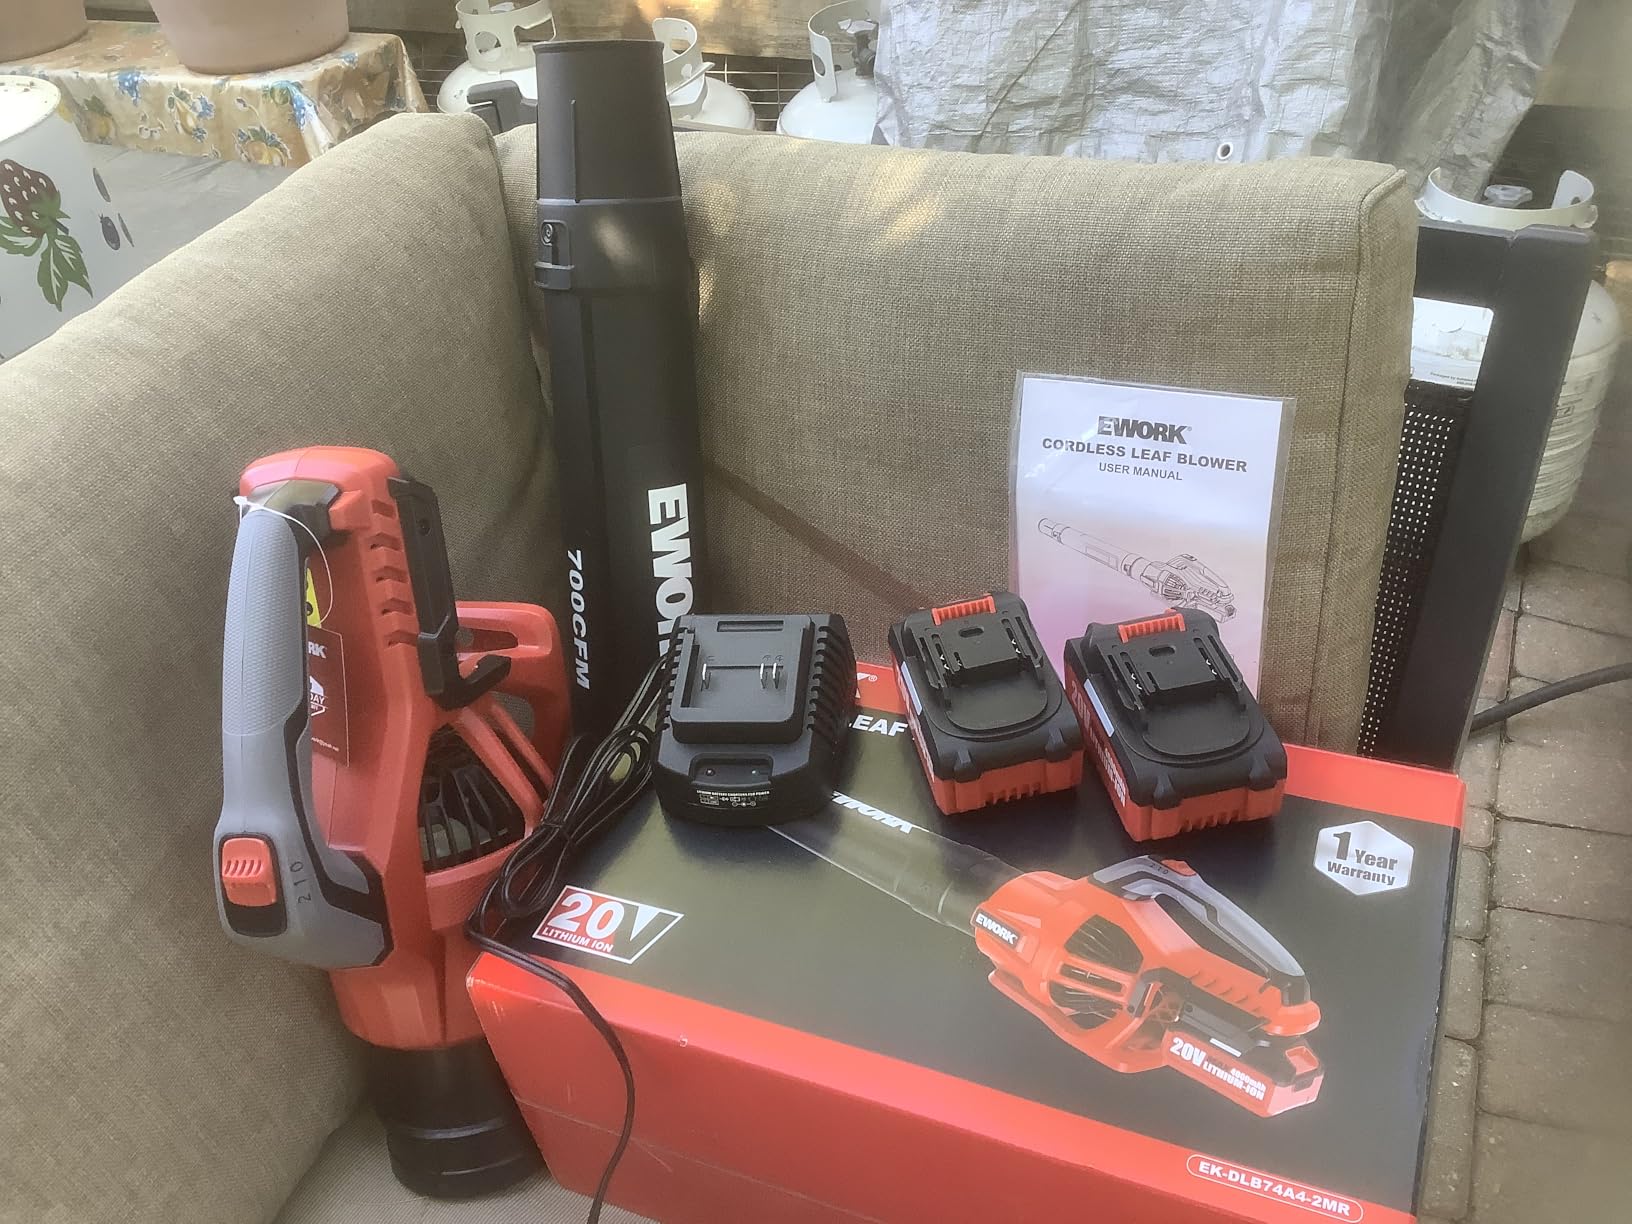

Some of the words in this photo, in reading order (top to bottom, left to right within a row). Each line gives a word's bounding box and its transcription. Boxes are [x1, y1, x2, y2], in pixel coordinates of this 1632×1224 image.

[1098, 415, 1188, 444] EWORK
[1042, 437, 1127, 458] CORDLESS
[1131, 447, 1172, 463] LEAF
[1177, 452, 1248, 473] BLOWER
[1099, 462, 1130, 475] USER
[1133, 467, 1183, 481] MANUAL
[648, 483, 694, 658] EWO
[567, 549, 591, 690] 700CFM
[850, 714, 908, 737] EAF
[832, 791, 914, 834] WORK
[1333, 831, 1352, 861] 1
[1355, 848, 1398, 871] Year
[1327, 861, 1396, 886] Warranty
[542, 926, 589, 947] LITHIUM
[590, 937, 615, 953] ION
[975, 912, 1018, 945] EWORK
[1169, 1036, 1207, 1067] 20V
[1202, 1060, 1267, 1101] LITHIUM-ION
[1198, 1160, 1351, 1217] EK-DLB74A4-2MR
